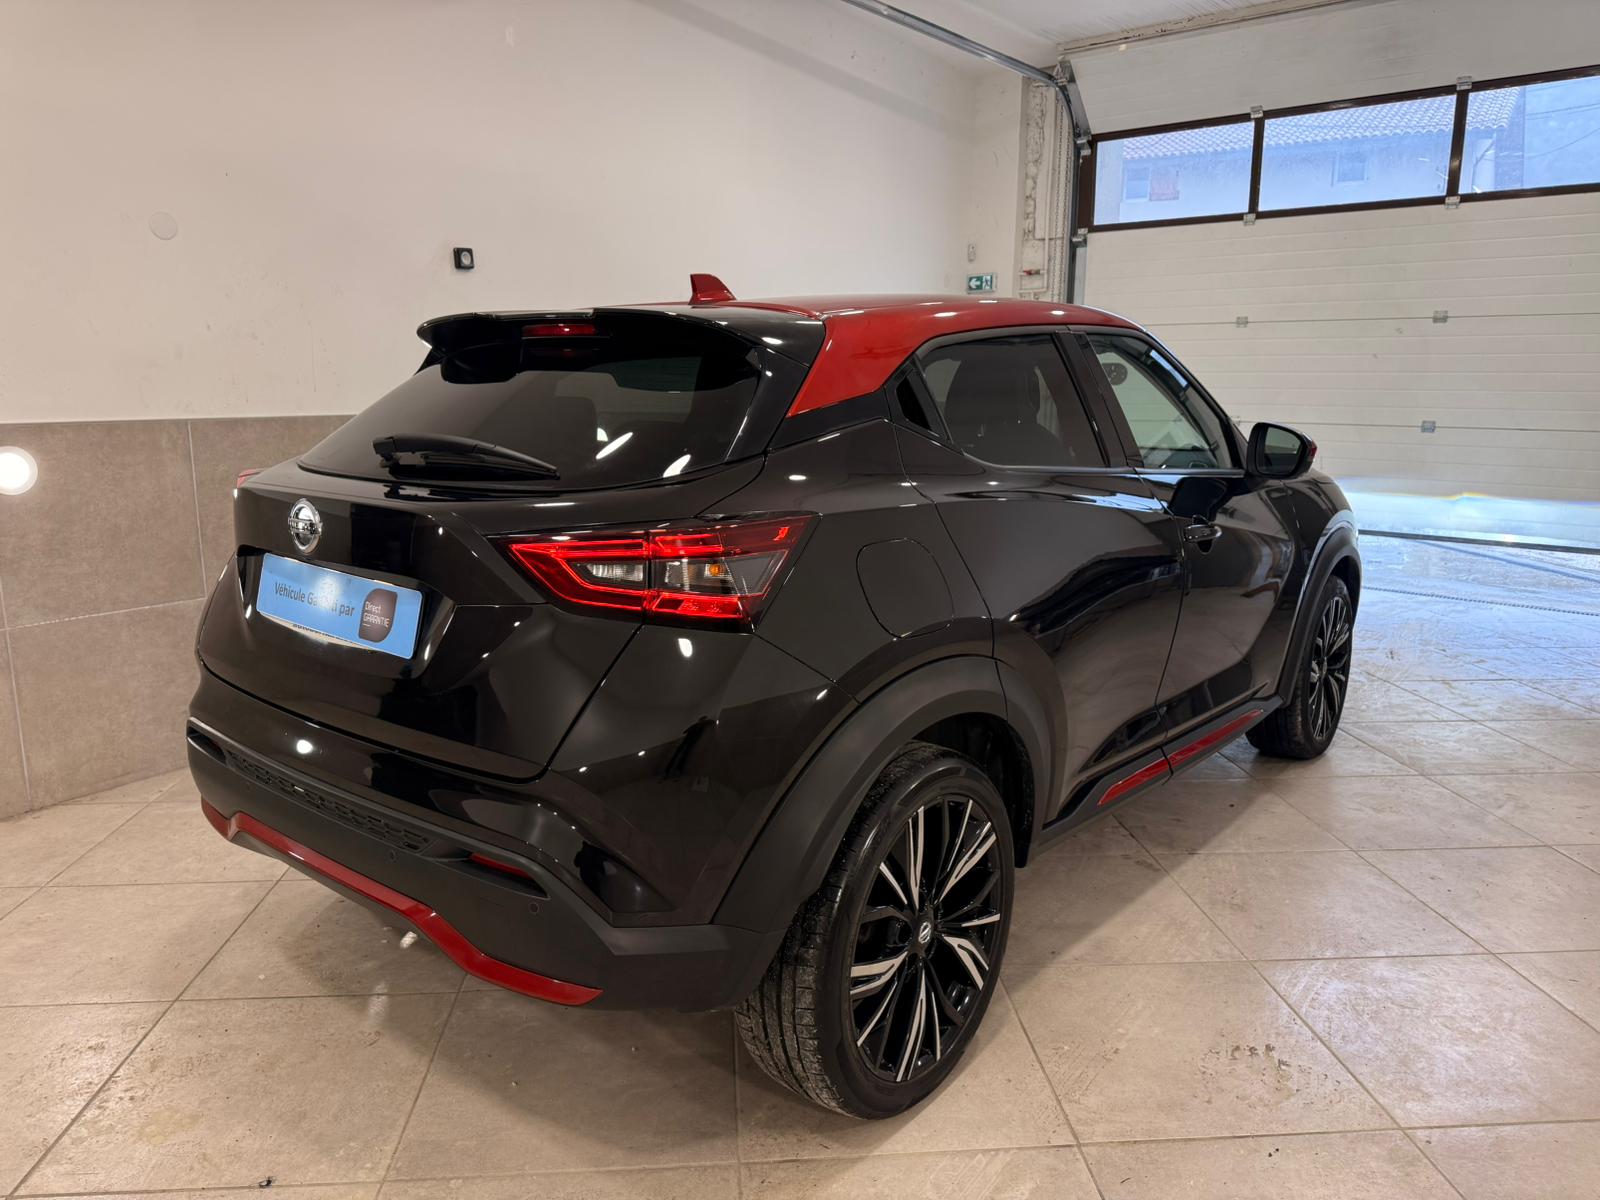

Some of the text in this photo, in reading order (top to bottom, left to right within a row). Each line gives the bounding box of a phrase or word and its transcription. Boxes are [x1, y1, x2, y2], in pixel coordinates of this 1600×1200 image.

[275, 582, 306, 603] Véhicule
[339, 603, 356, 617] par
[365, 601, 382, 614] Direct
